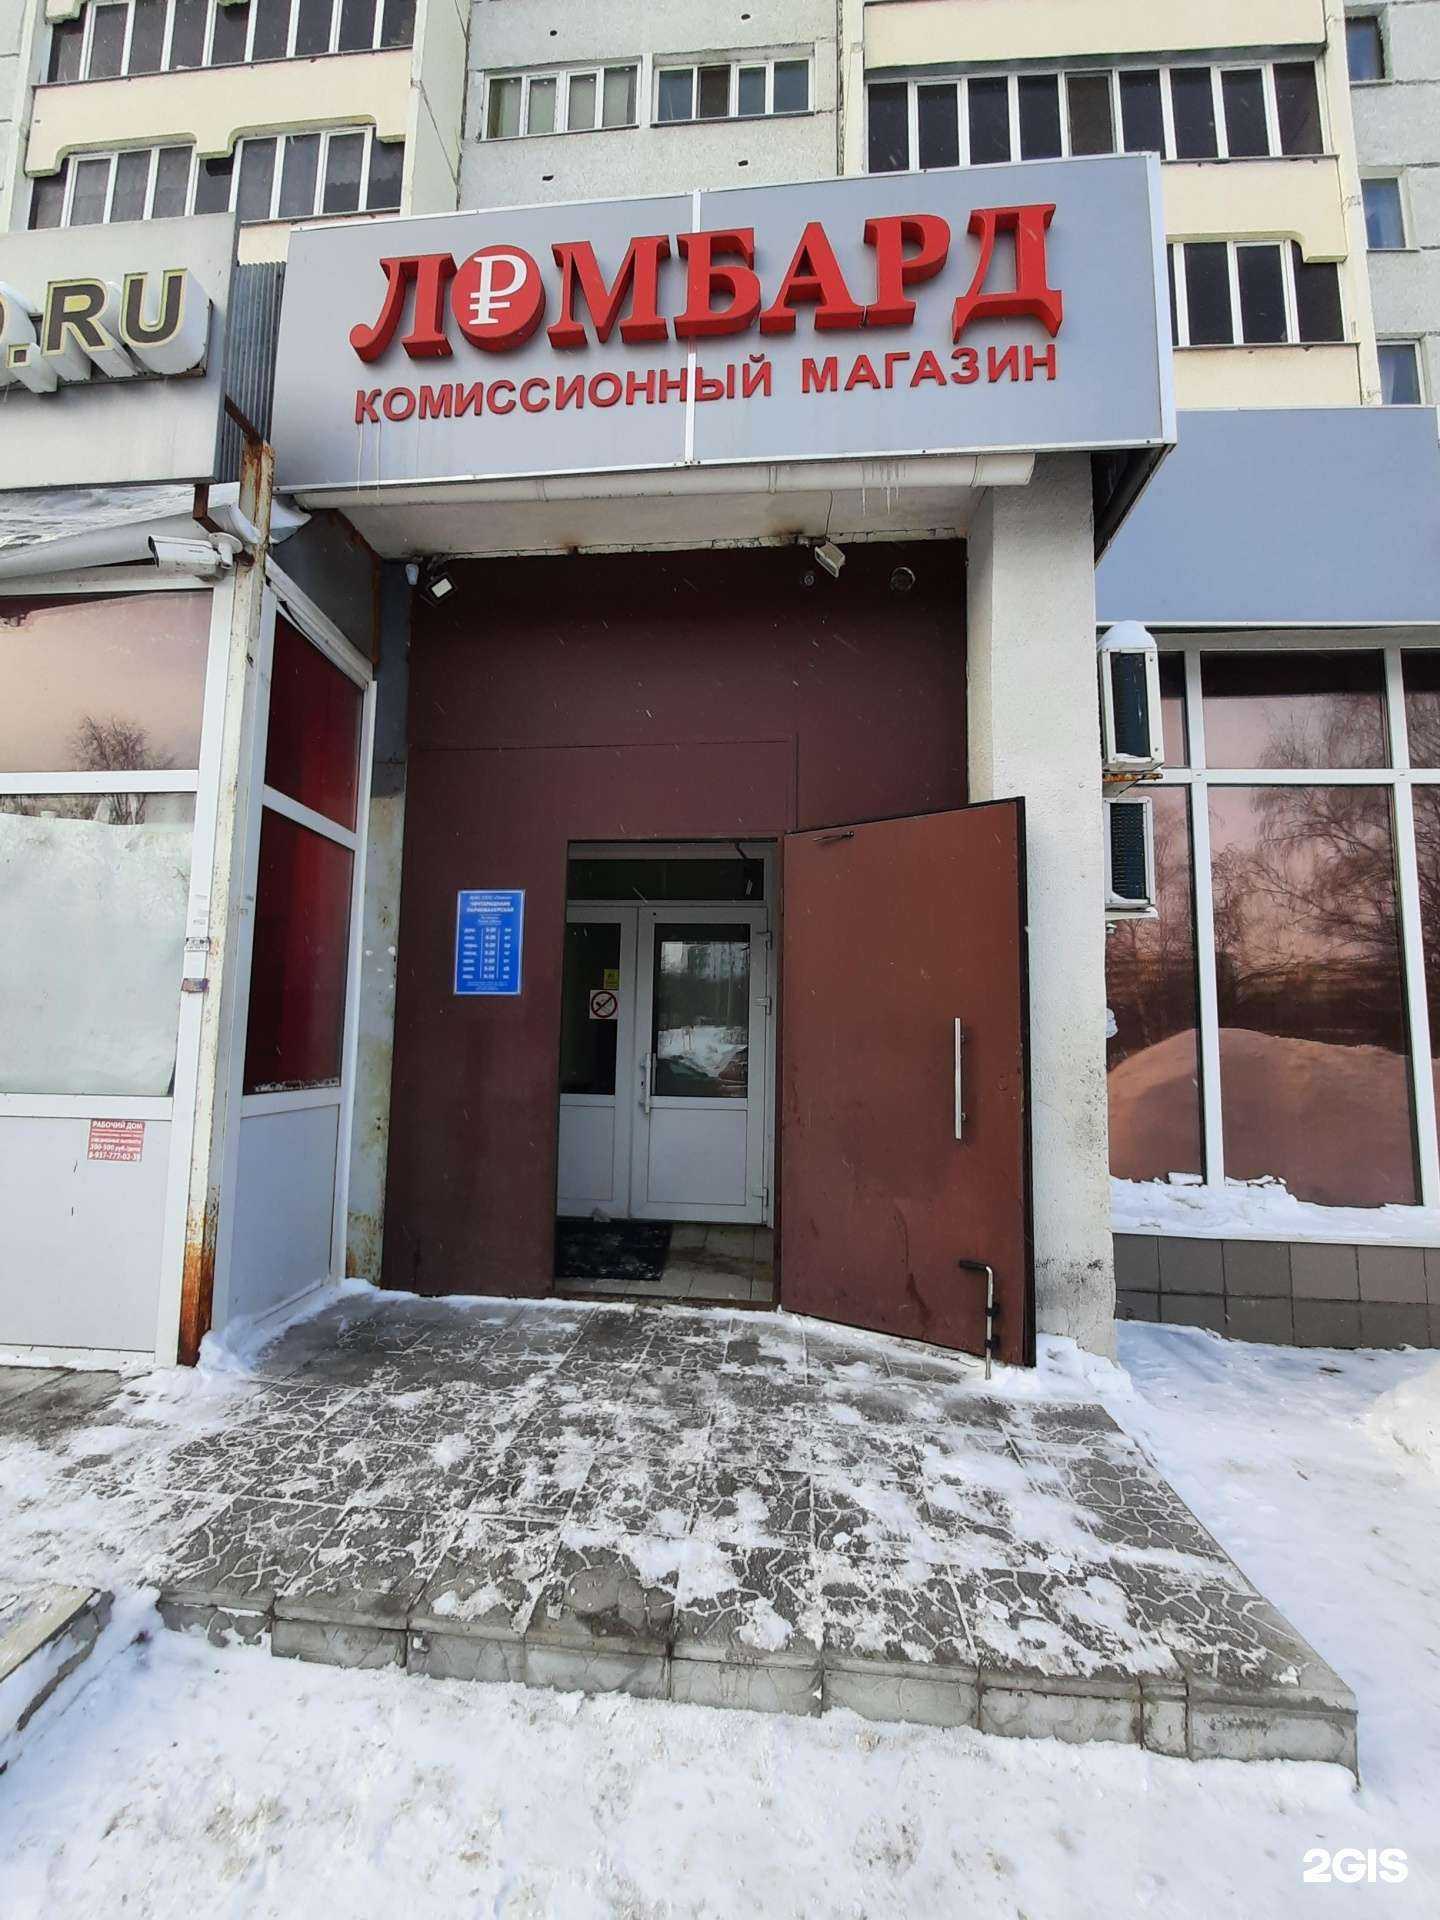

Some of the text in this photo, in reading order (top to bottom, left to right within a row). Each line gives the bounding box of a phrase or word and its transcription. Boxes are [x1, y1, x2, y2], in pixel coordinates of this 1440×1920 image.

[0, 267, 189, 368] .RU
[350, 203, 1064, 363] ЛОМБАРД
[354, 342, 1058, 424] КОМИССИОННЫЙ МАГАЗИН
[92, 1120, 143, 1130] РАБОЧИЙ ДОМ
